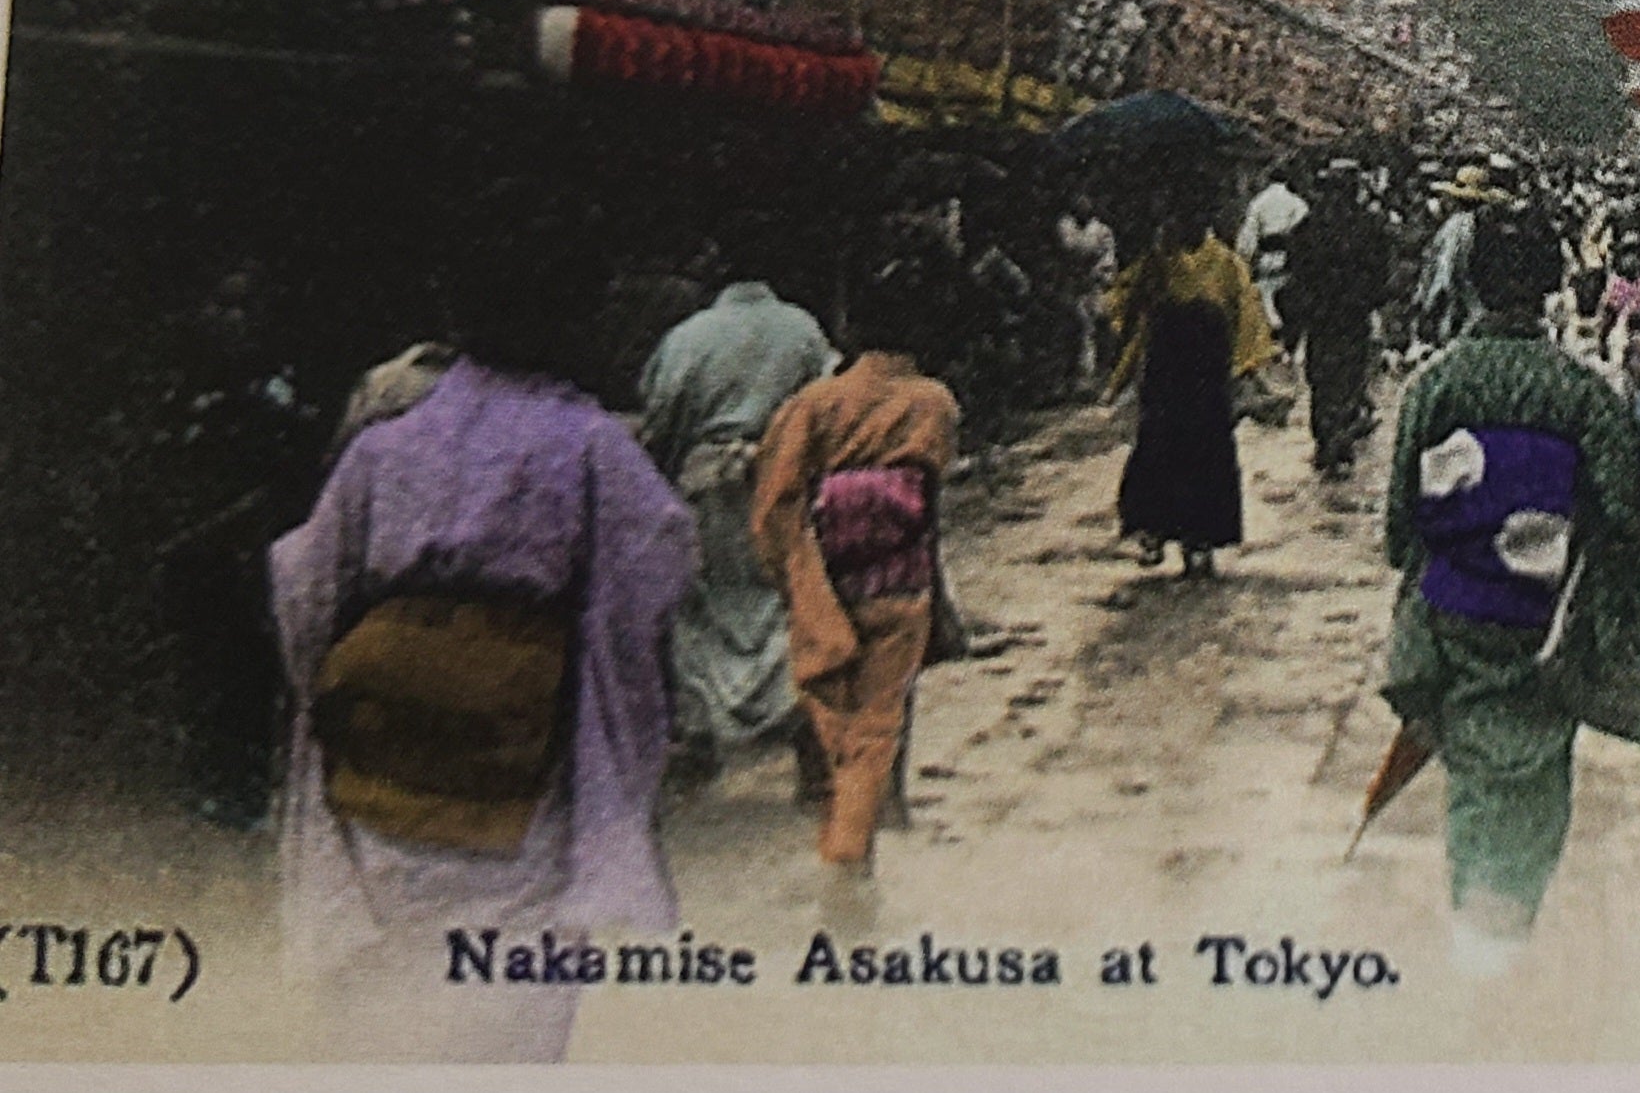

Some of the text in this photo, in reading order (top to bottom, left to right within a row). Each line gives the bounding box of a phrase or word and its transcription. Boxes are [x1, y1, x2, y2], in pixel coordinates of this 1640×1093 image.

[446, 928, 1400, 1001] Nakamise Asakusa at Tokyo.
